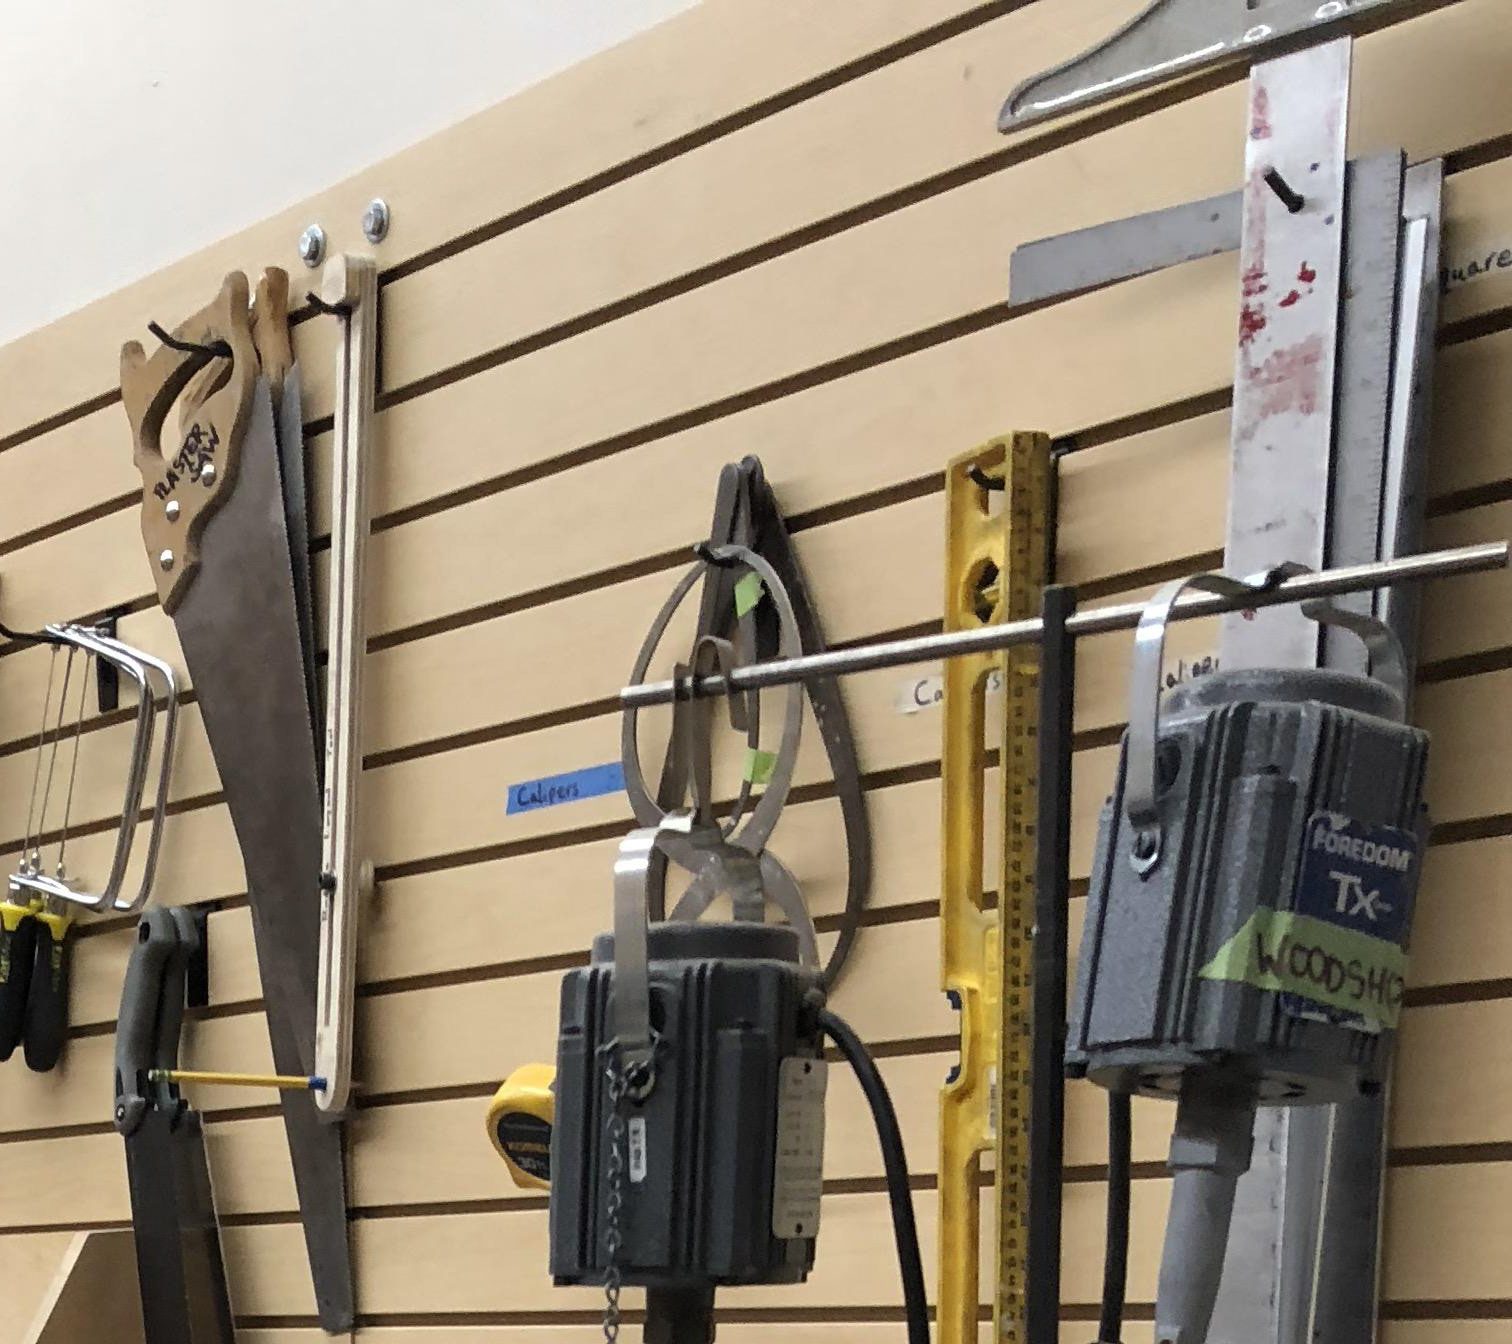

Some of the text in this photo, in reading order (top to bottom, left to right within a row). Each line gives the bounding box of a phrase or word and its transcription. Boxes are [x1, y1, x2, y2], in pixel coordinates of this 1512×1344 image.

[191, 422, 220, 484] SAW
[517, 782, 579, 806] Calipers
[1313, 824, 1411, 872] FOREDOM
